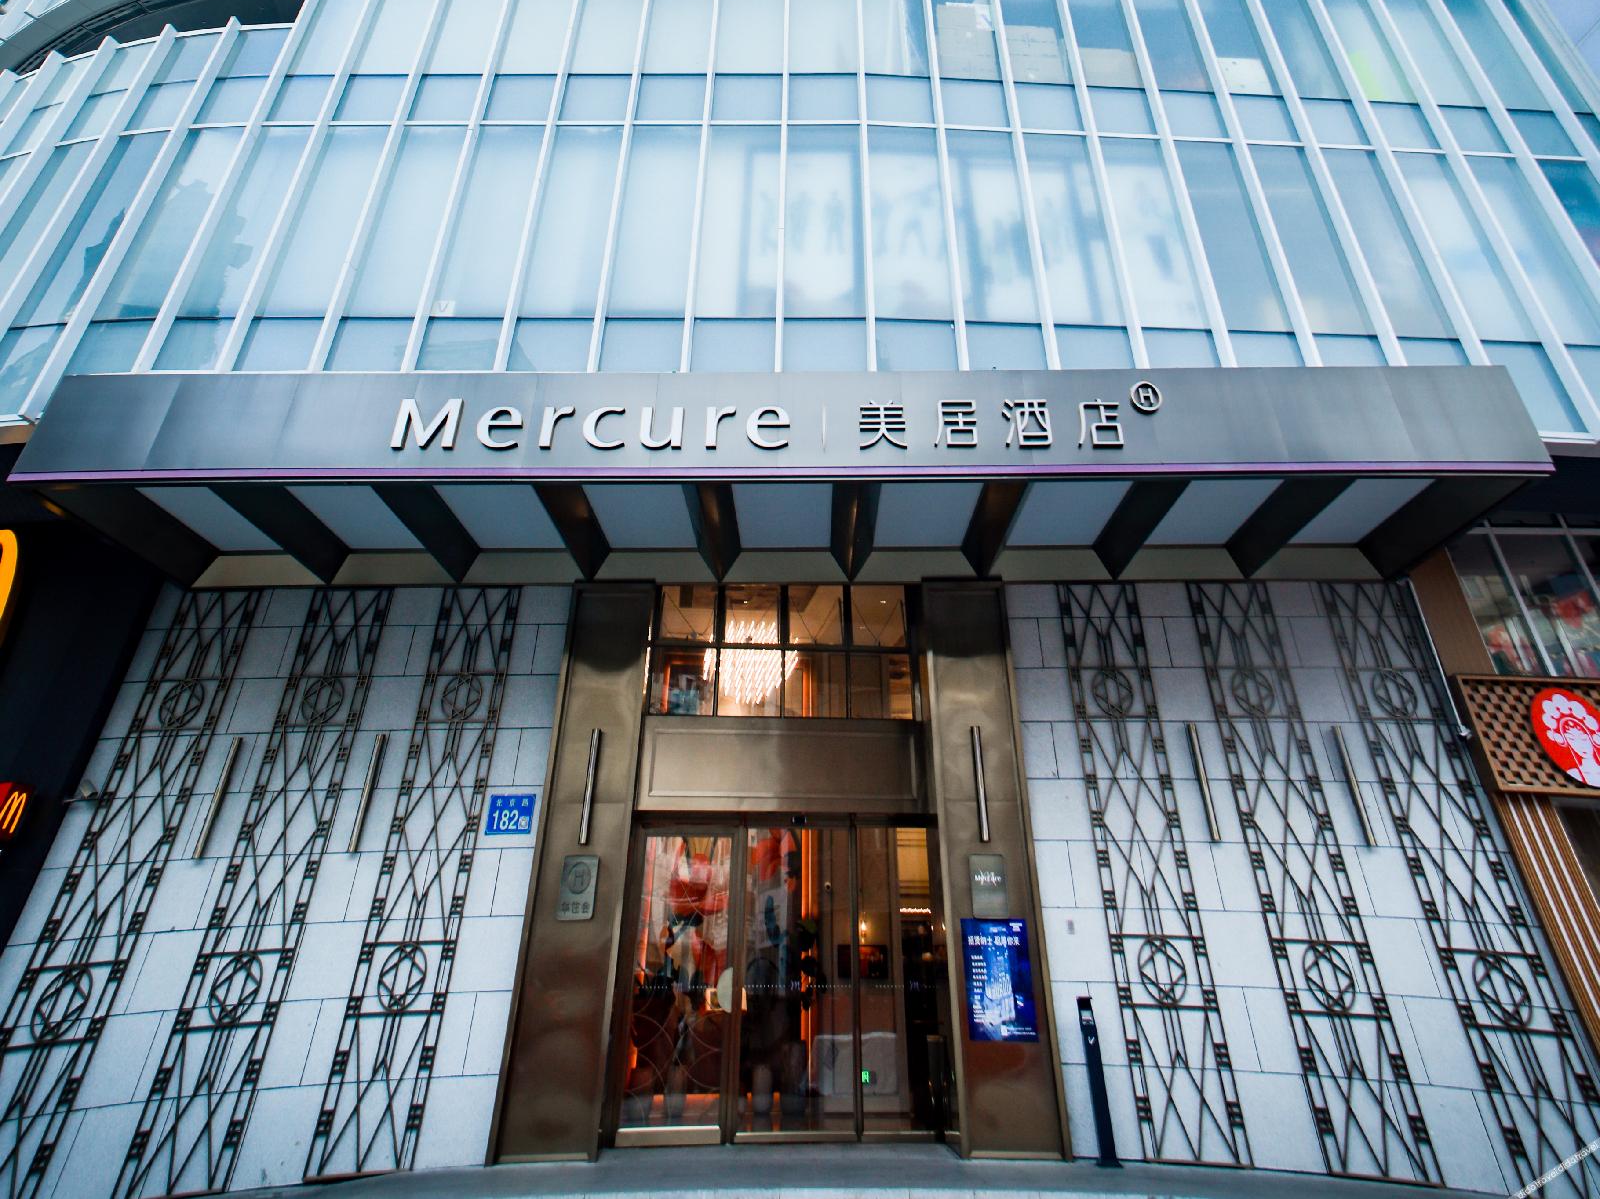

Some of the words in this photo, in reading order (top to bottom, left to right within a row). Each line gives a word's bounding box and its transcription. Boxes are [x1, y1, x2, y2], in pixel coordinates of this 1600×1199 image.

[390, 397, 791, 451] Mercure
[859, 398, 1125, 451] 美居酒店
[492, 809, 519, 830] 182
